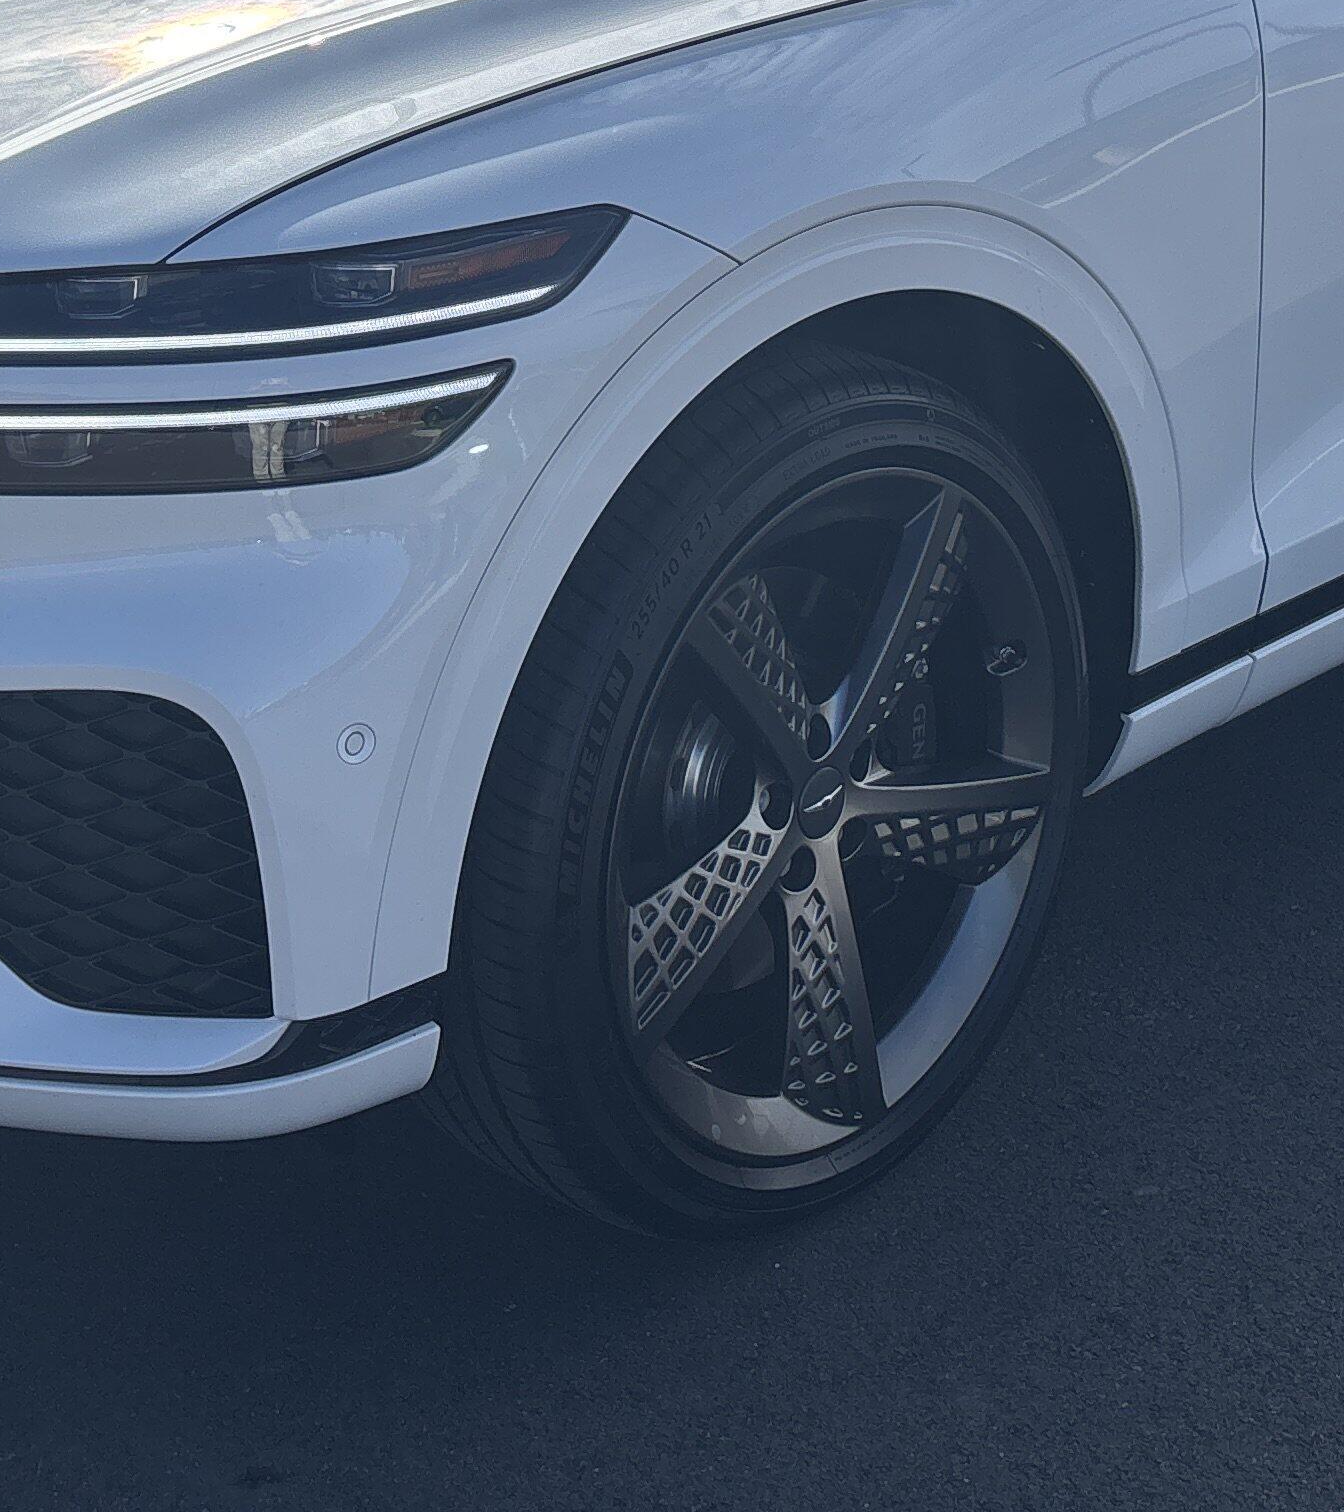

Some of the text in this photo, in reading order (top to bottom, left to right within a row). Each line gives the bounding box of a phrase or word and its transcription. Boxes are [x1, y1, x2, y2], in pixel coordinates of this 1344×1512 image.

[631, 511, 712, 639] 255/40 R 21
[559, 664, 626, 896] MICHELIN
